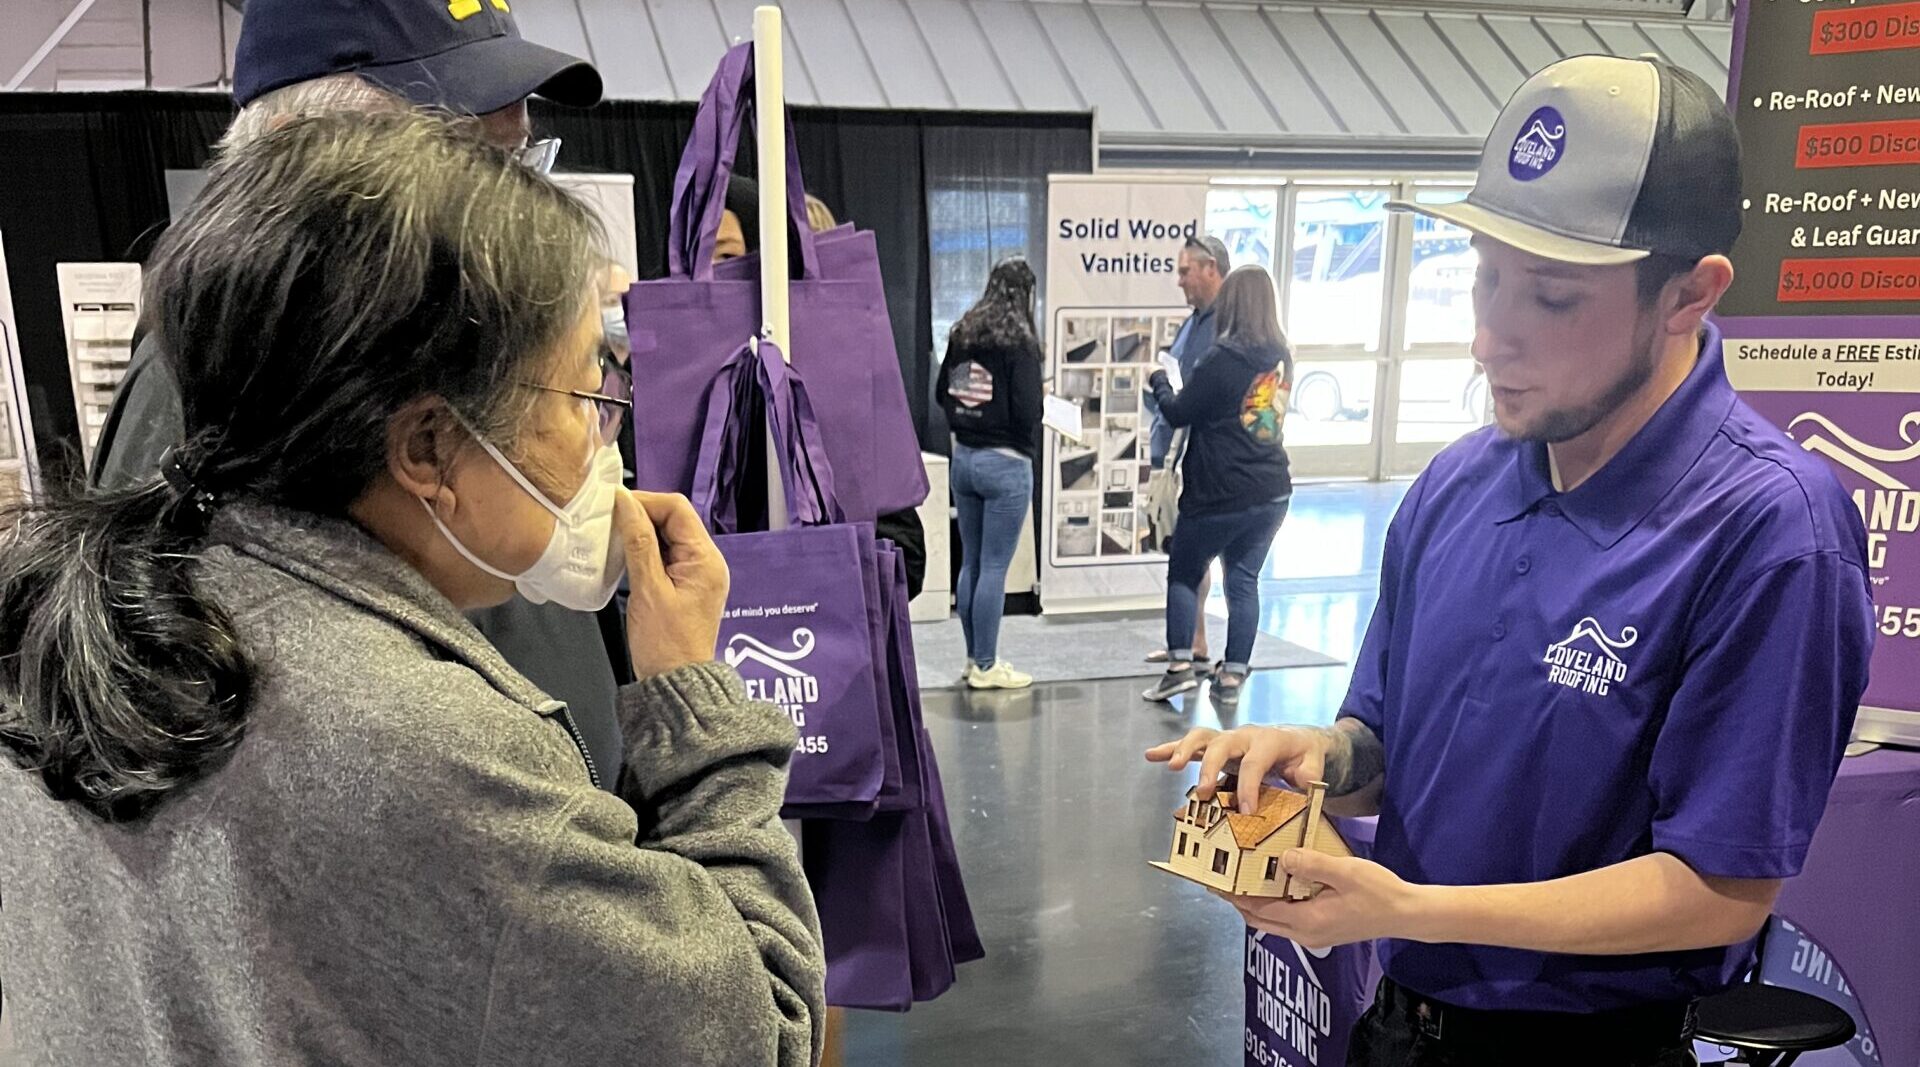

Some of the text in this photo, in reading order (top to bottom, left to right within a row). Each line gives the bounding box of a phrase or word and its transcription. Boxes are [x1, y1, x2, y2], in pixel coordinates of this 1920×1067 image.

[1820, 20, 1878, 45] $300
[1769, 86, 1857, 111] Re-Roof
[1805, 132, 1920, 159] $500 Disc
[1765, 189, 1857, 213] Re-Roof
[1059, 217, 1198, 240] Solid Wood
[1791, 226, 1807, 248] &
[1812, 224, 1863, 247] Leaf
[1080, 252, 1175, 273] Vanities
[1782, 270, 1920, 294] $1,000 Disco
[1738, 344, 1920, 362] Schedule a FREE Esti
[1816, 371, 1875, 392] Today!
[732, 608, 741, 619] of
[741, 605, 763, 617] mind
[764, 606, 781, 618] you
[1543, 644, 1627, 683] LOVELAND
[1547, 664, 1611, 696] ROOFING
[1246, 934, 1331, 1037] LOVELAND
[1257, 984, 1318, 1067] ROOFING
[1245, 1026, 1293, 1067] 916-7
